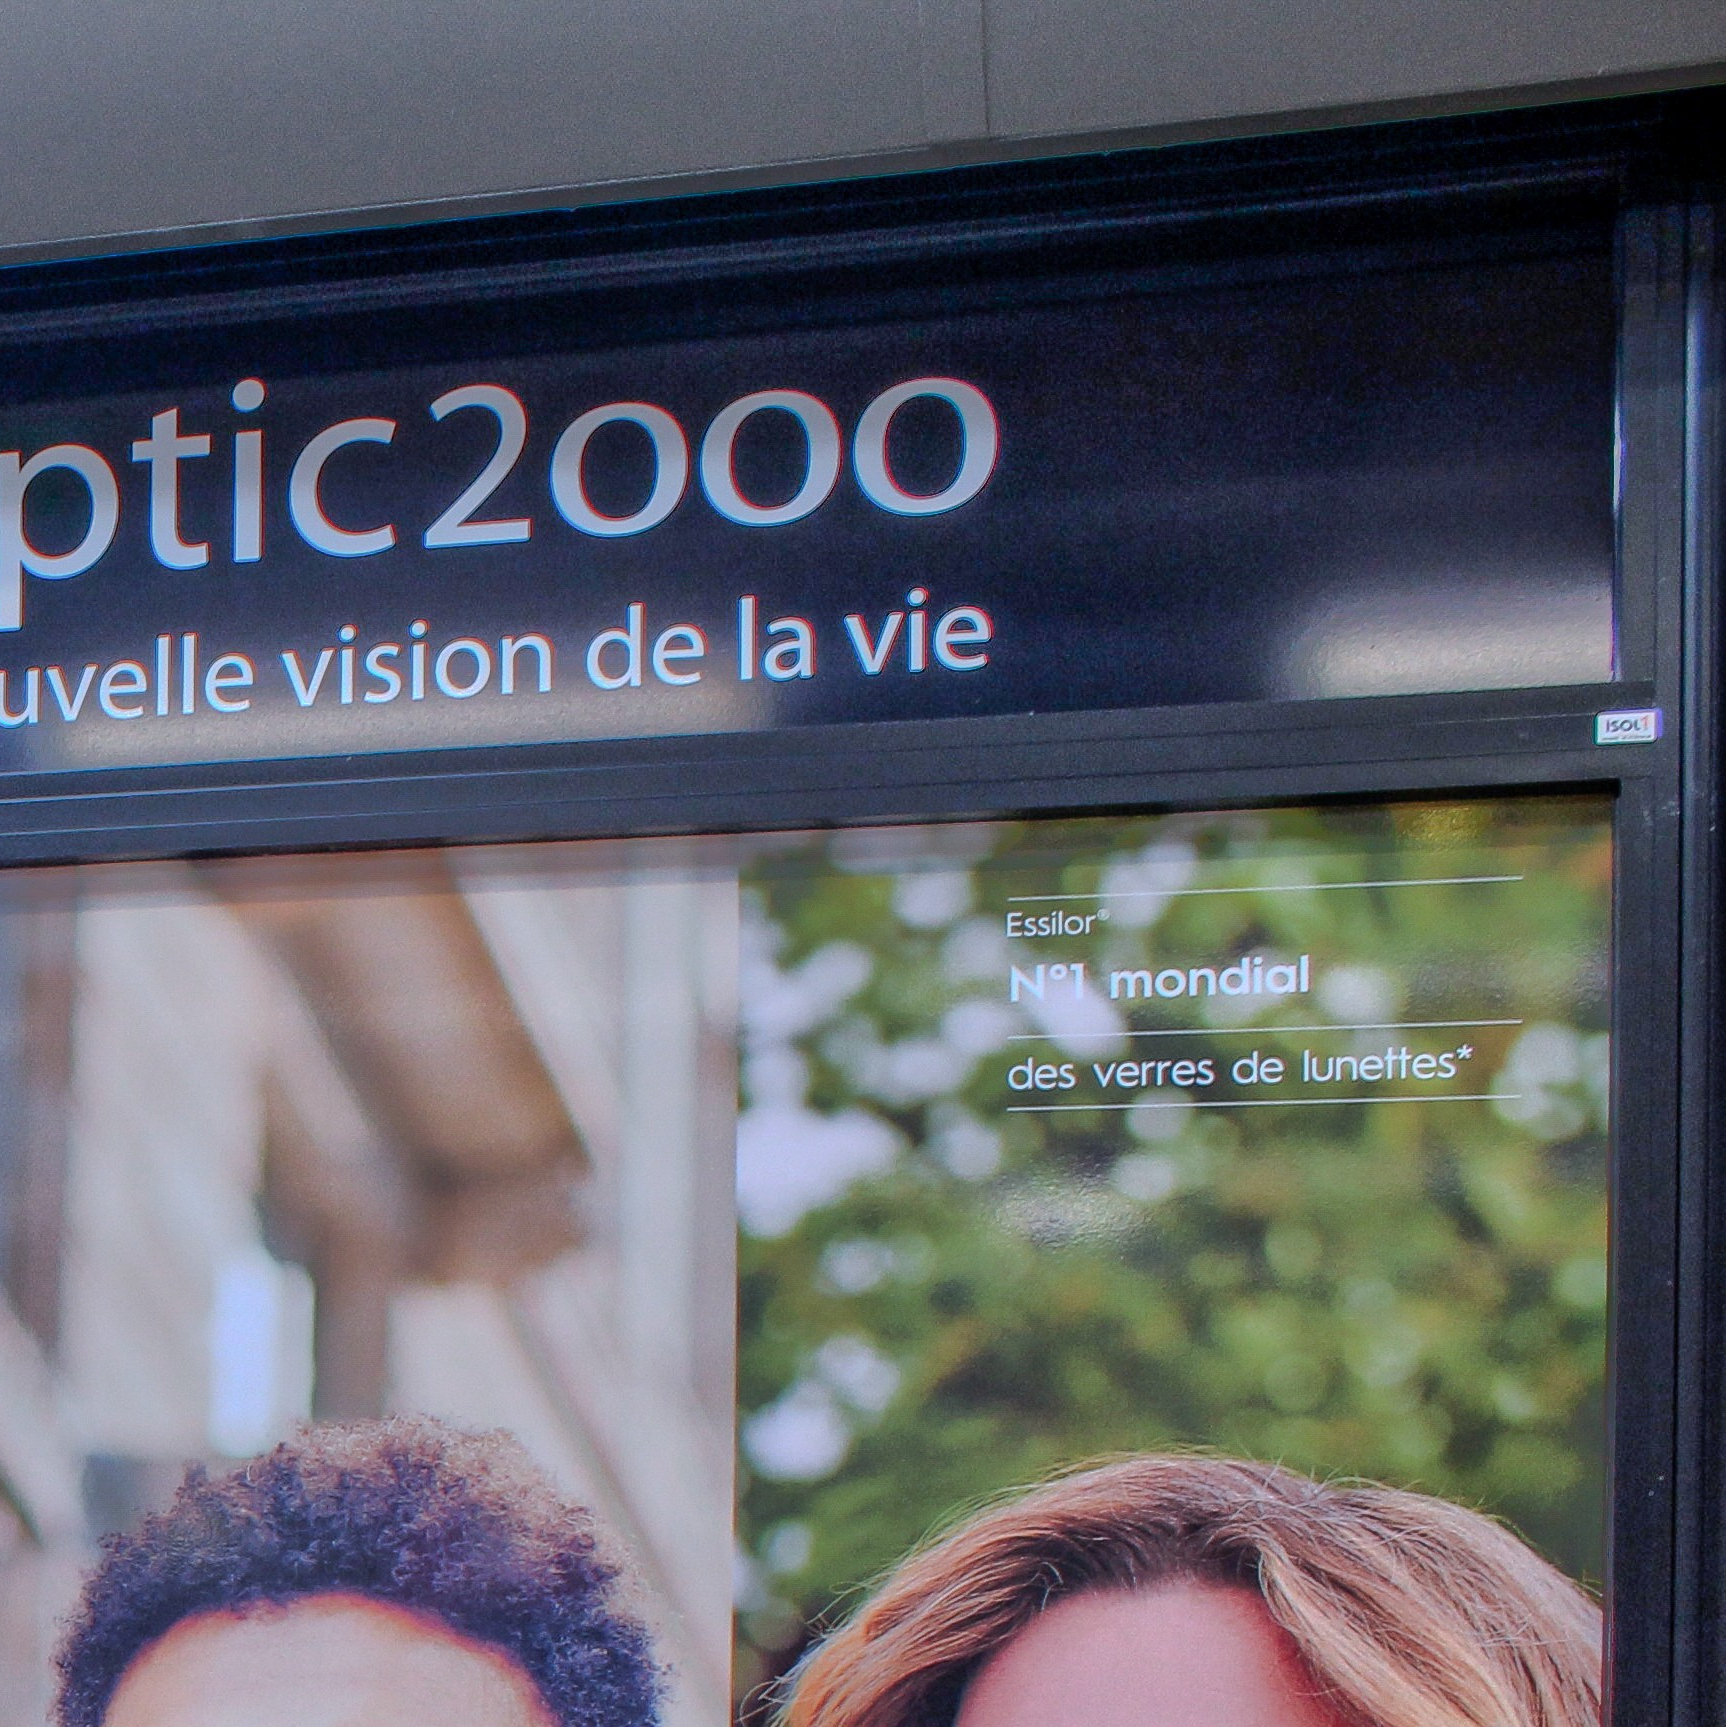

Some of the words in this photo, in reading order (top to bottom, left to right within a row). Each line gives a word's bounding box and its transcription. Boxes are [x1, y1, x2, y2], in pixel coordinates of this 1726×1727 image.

[280, 618, 553, 708] vision
[585, 602, 707, 691] de
[736, 594, 816, 682] la
[845, 586, 994, 676] vie
[1008, 961, 1087, 1004] N°1
[1110, 953, 1311, 1000] mondial
[1007, 1054, 1077, 1092] des
[1093, 1057, 1217, 1090] verres
[1232, 1048, 1285, 1085] de
